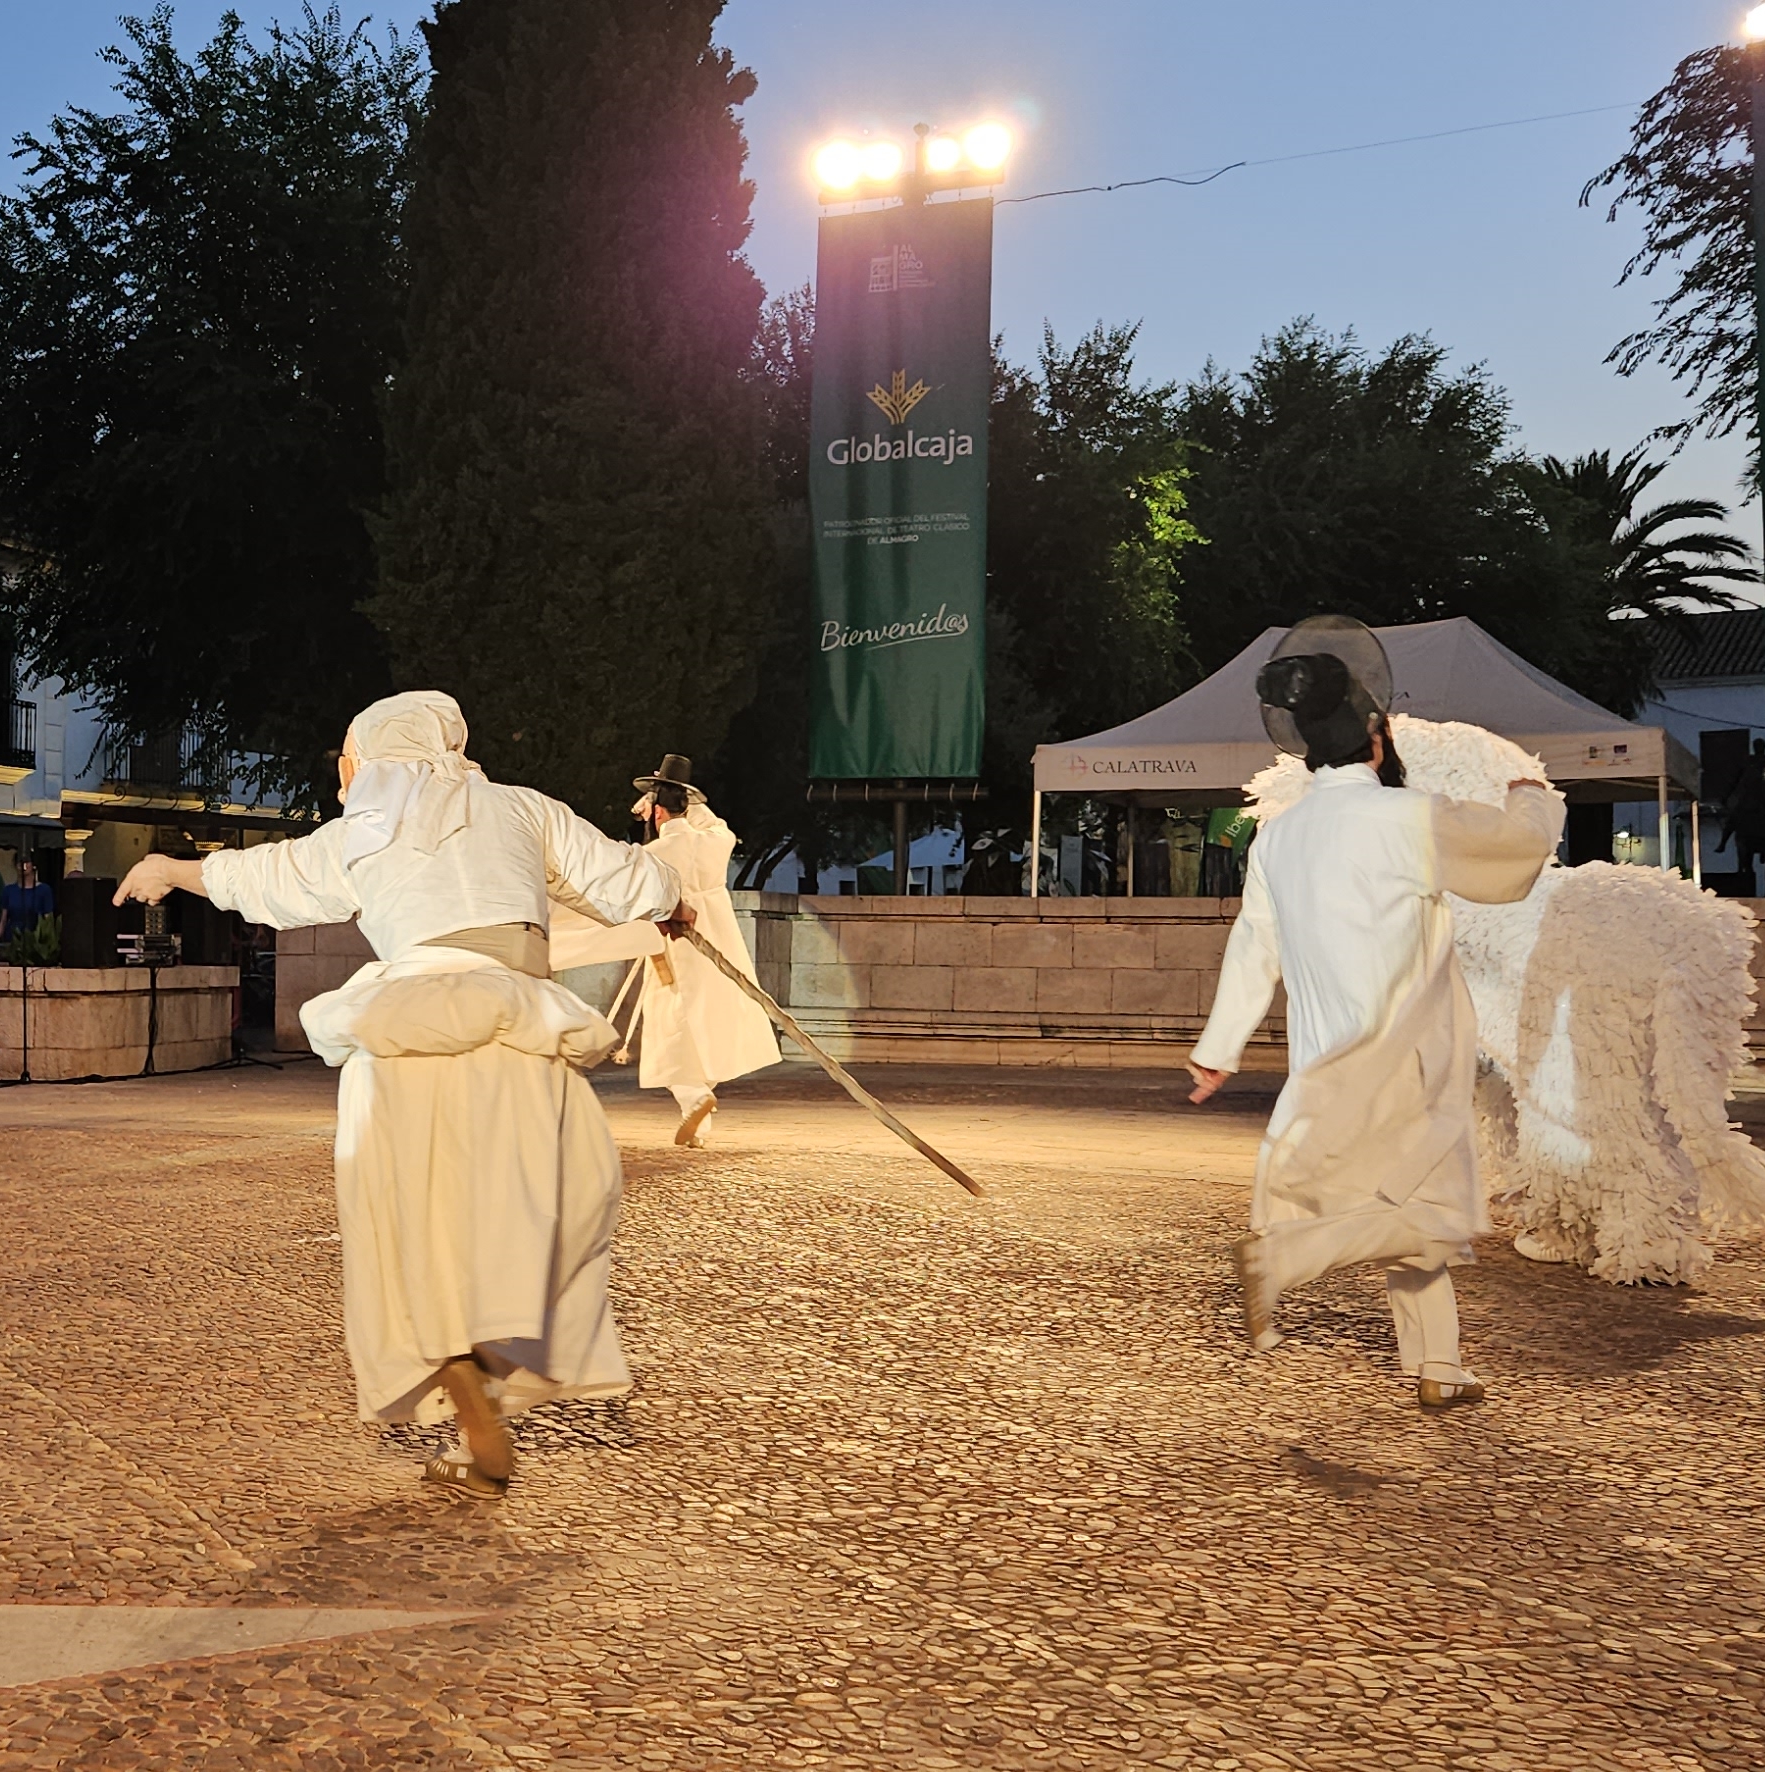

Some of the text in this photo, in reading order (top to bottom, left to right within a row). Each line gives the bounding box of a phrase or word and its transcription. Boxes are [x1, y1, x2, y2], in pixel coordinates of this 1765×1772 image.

[826, 428, 973, 465] Globalcaja
[823, 517, 882, 528] PATRONADOR
[913, 514, 930, 523] DEL
[931, 513, 970, 522] FESTIVAL
[900, 523, 931, 533] TEATRO
[880, 534, 919, 544] ALMAGRO
[820, 602, 969, 651] Bienvenid@s
[1092, 759, 1197, 774] CALATRAVA
